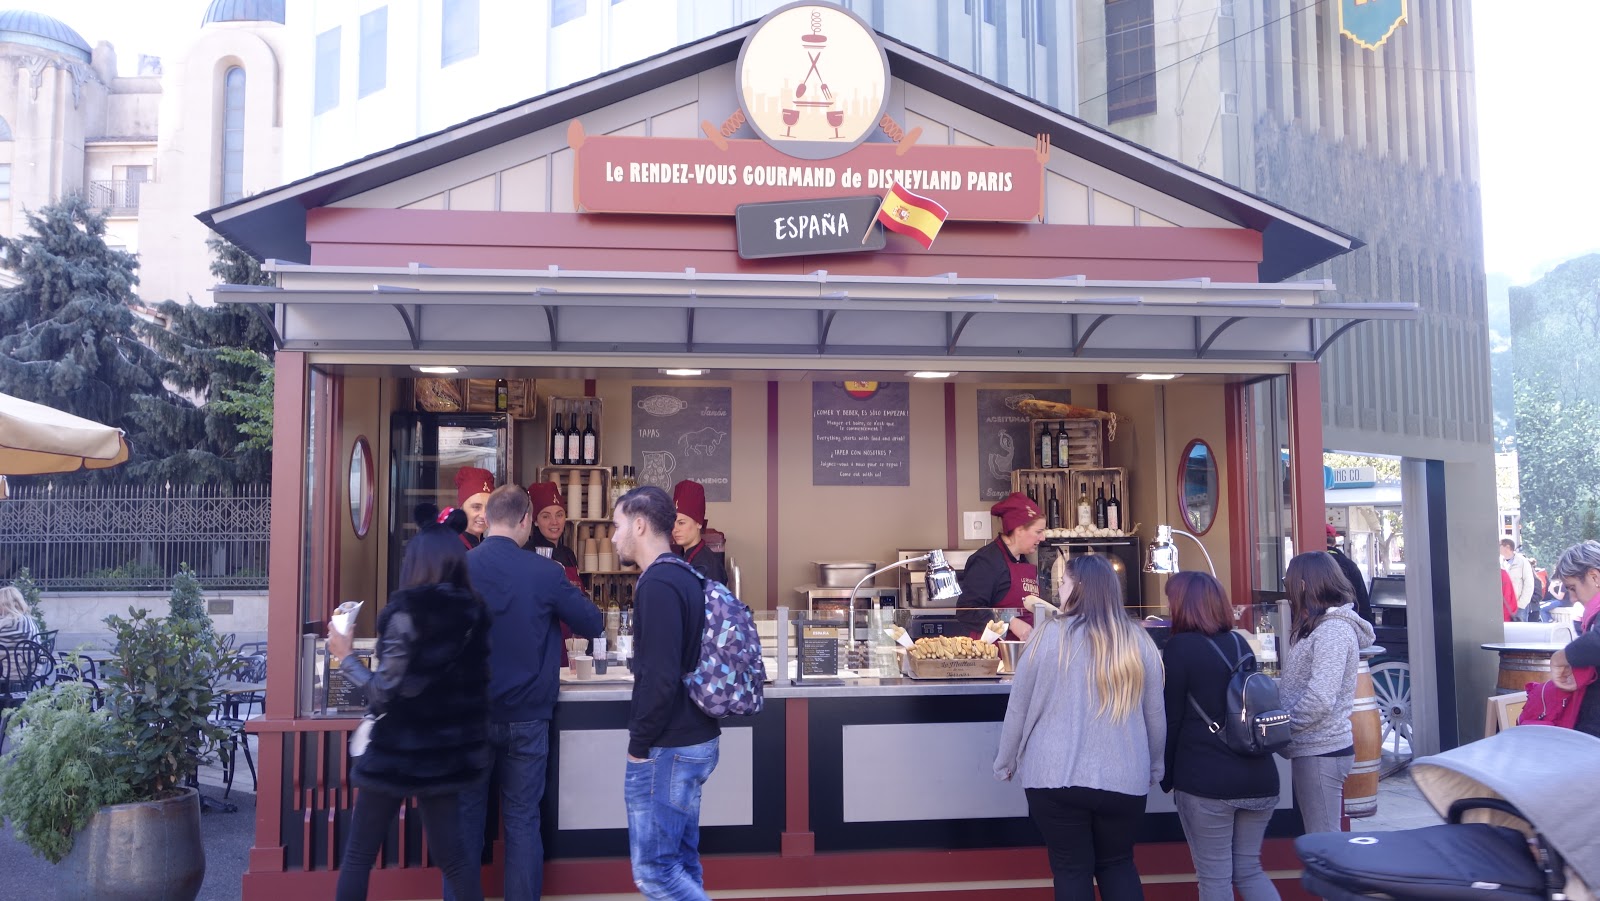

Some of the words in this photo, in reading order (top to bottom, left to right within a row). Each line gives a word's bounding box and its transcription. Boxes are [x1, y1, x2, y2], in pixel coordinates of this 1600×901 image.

[606, 162, 624, 182] Le
[630, 162, 737, 186] RENDEZ-VOUS
[742, 166, 836, 188] GOURMAND
[841, 168, 862, 188] de
[868, 168, 962, 190] DISNEYLAND
[967, 171, 1012, 192] PARIS
[774, 212, 850, 240] ESPAÑA
[639, 428, 660, 438] TAPAS
[1334, 469, 1346, 482] ING
